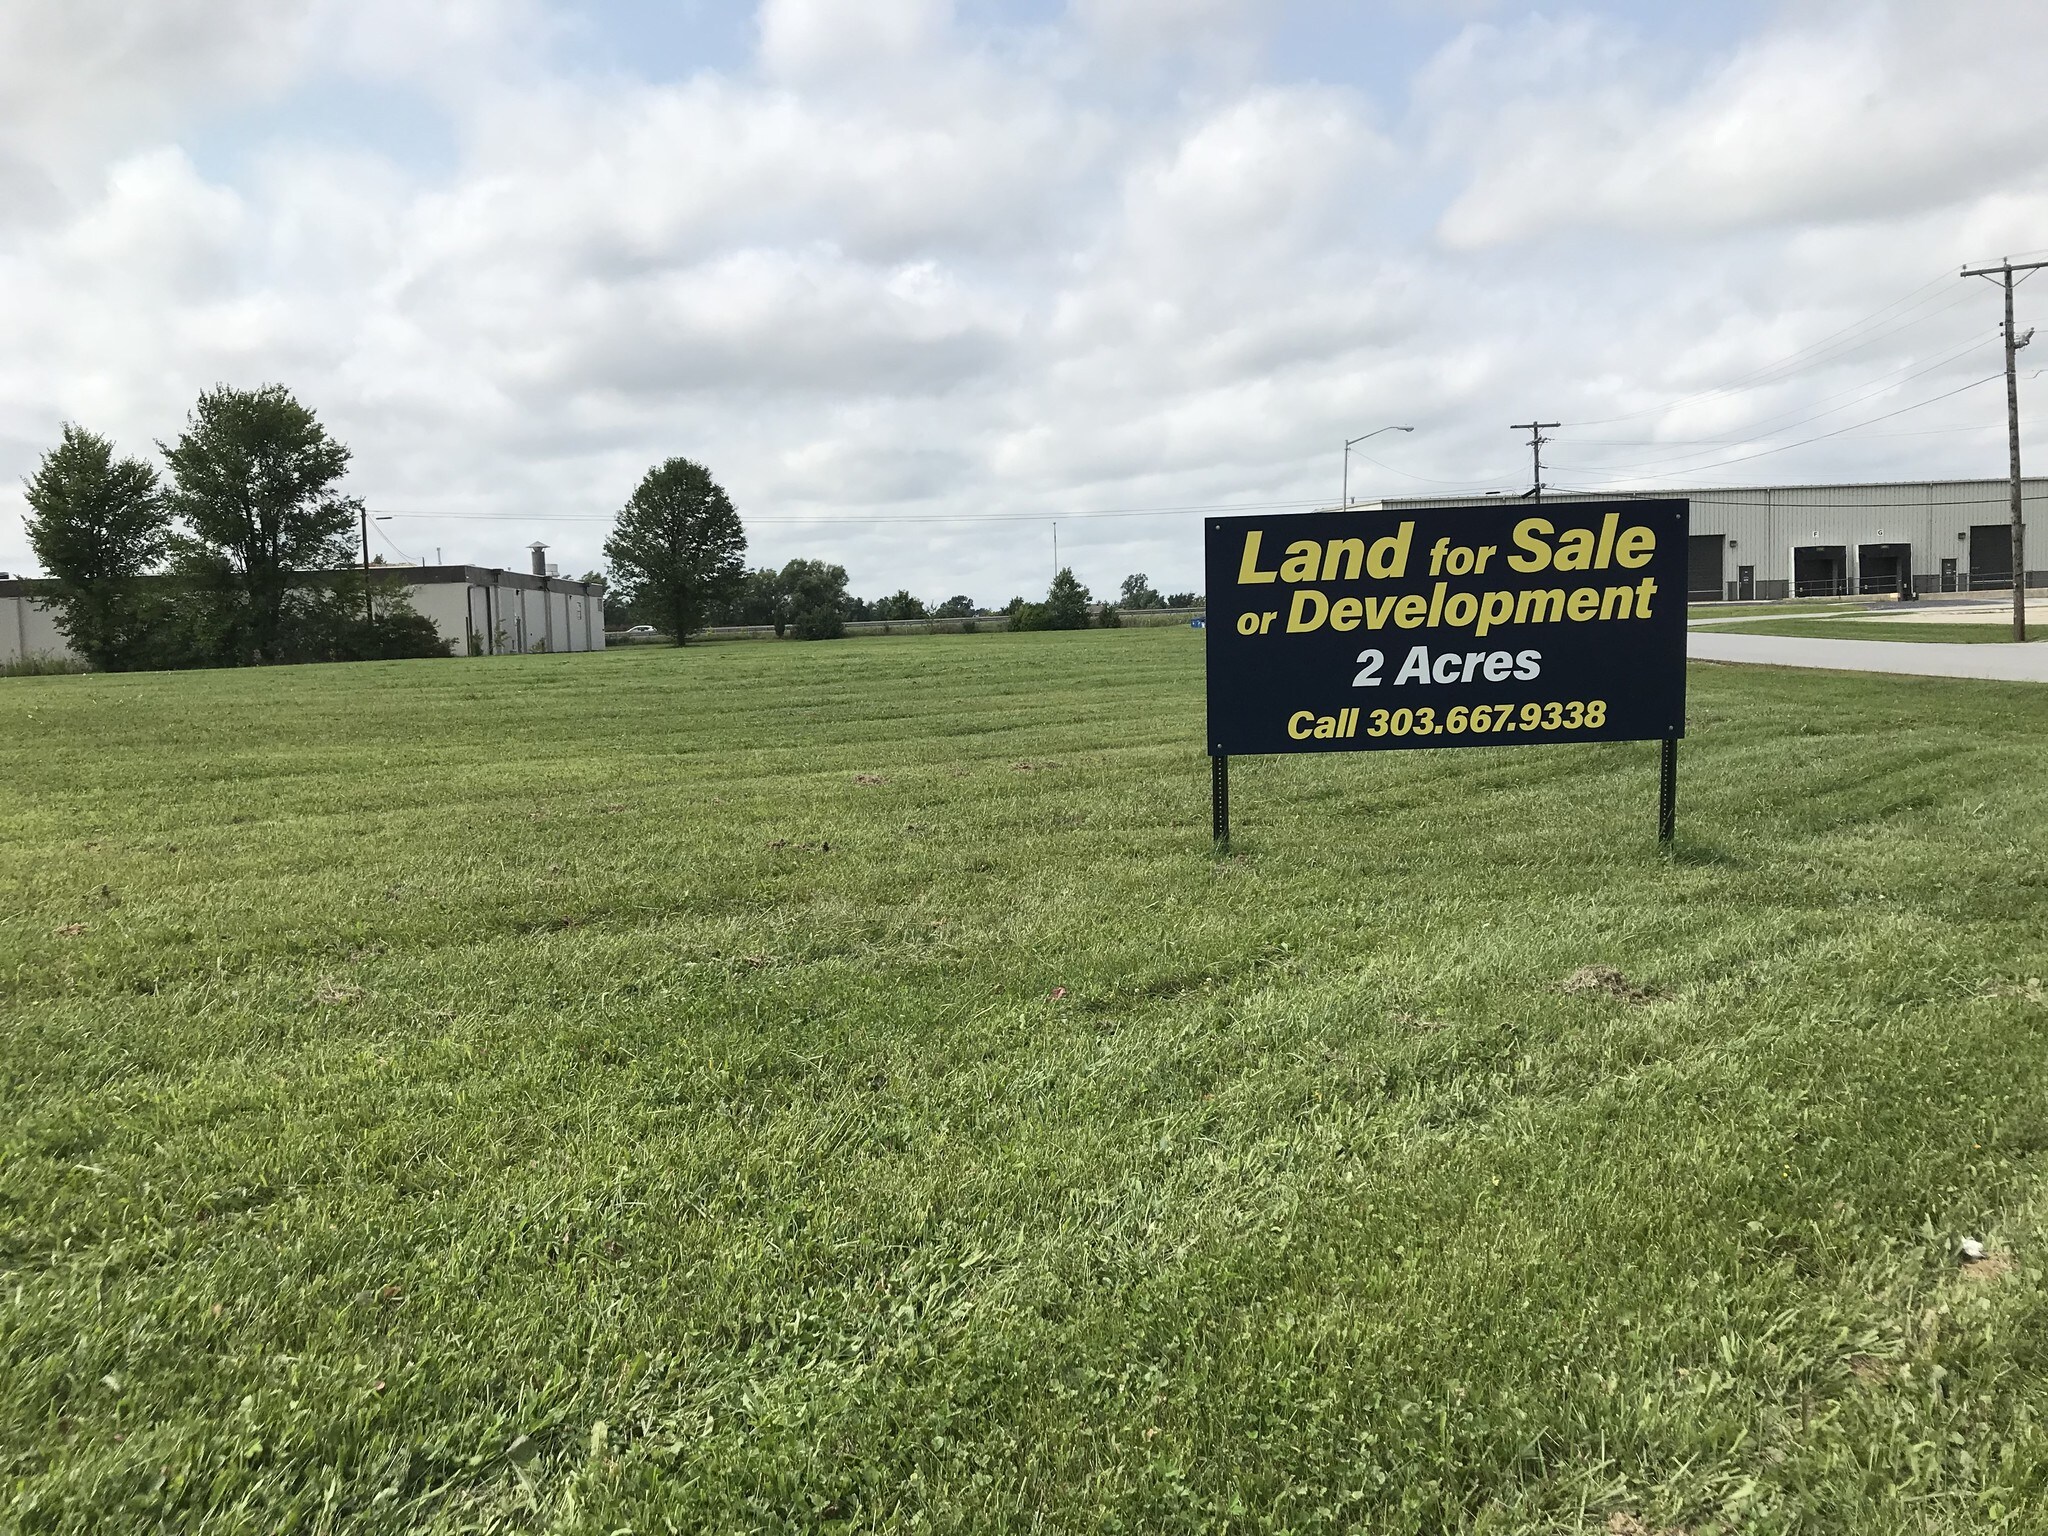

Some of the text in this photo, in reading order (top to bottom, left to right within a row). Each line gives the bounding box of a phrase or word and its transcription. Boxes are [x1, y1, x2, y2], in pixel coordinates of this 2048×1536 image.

[1238, 513, 1656, 584] Land for Sale
[1237, 577, 1658, 636] or Development
[1352, 646, 1541, 687] 2 Acres
[1288, 700, 1607, 740] Call 303.667.9338
